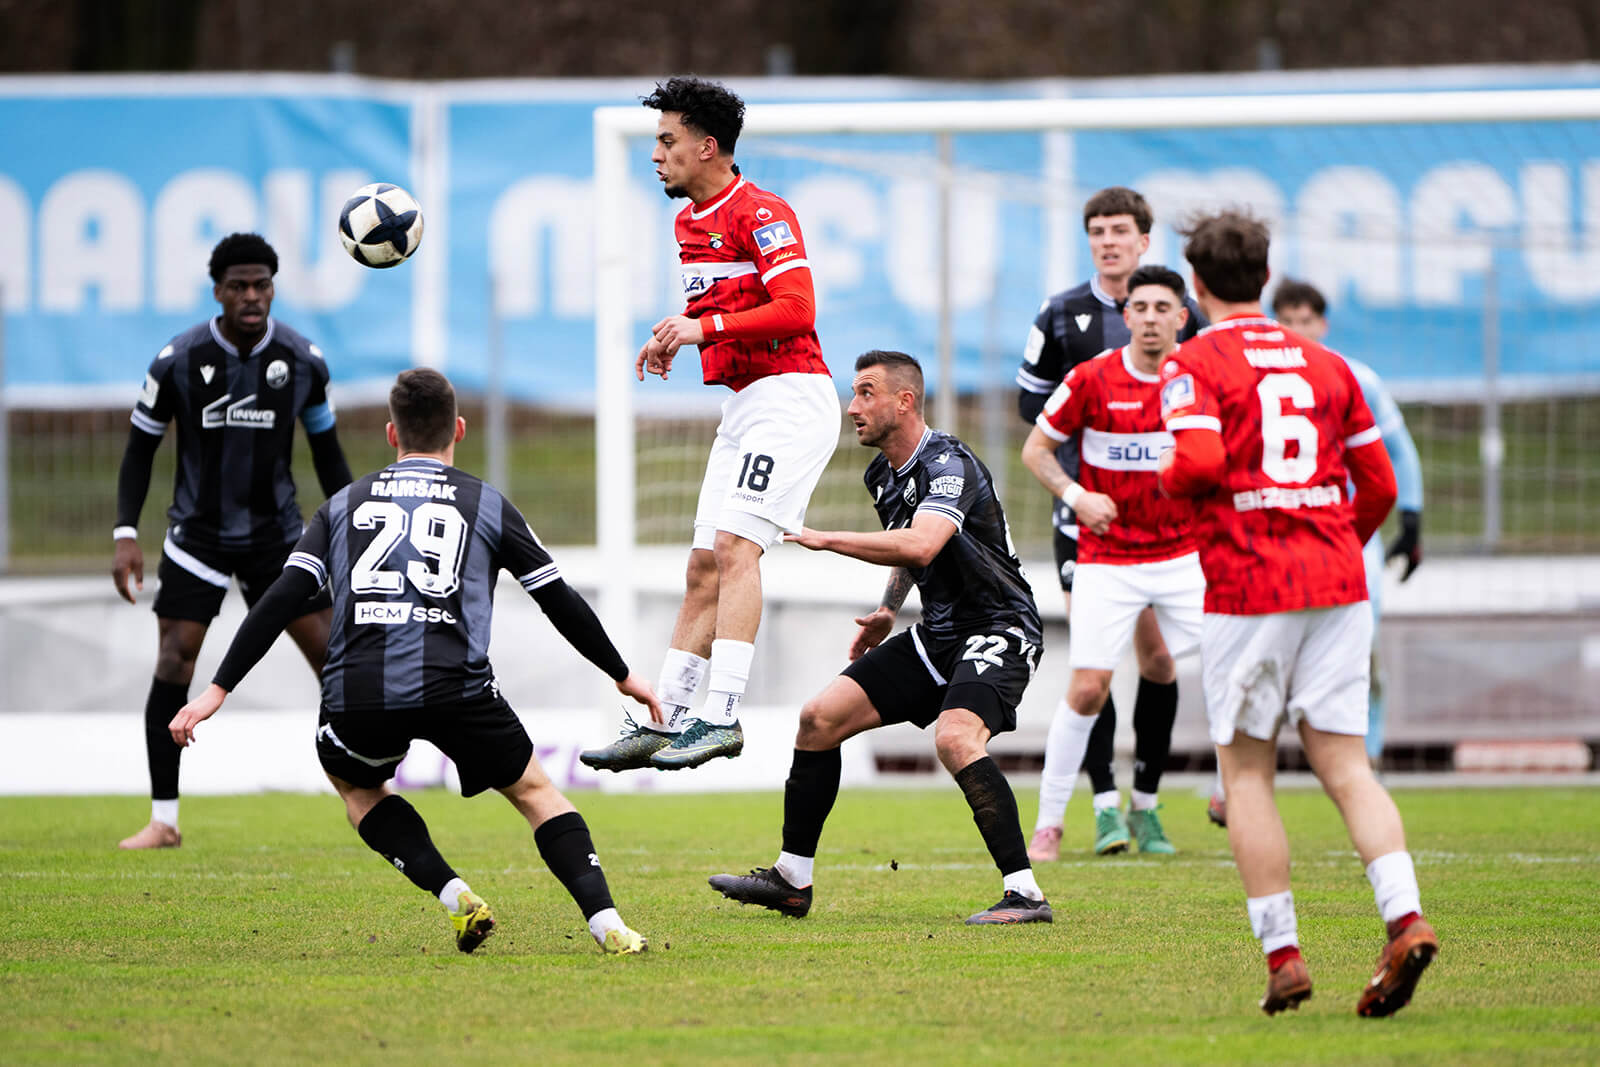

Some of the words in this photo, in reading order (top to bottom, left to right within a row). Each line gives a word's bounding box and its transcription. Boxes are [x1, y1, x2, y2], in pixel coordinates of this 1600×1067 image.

[0, 167, 374, 314] AFU
[1257, 372, 1318, 484] 6
[370, 479, 458, 501] RAMŠAK
[737, 452, 775, 493] 18
[351, 500, 468, 598] 29
[360, 607, 403, 620] HCM
[962, 634, 1009, 668] 22
